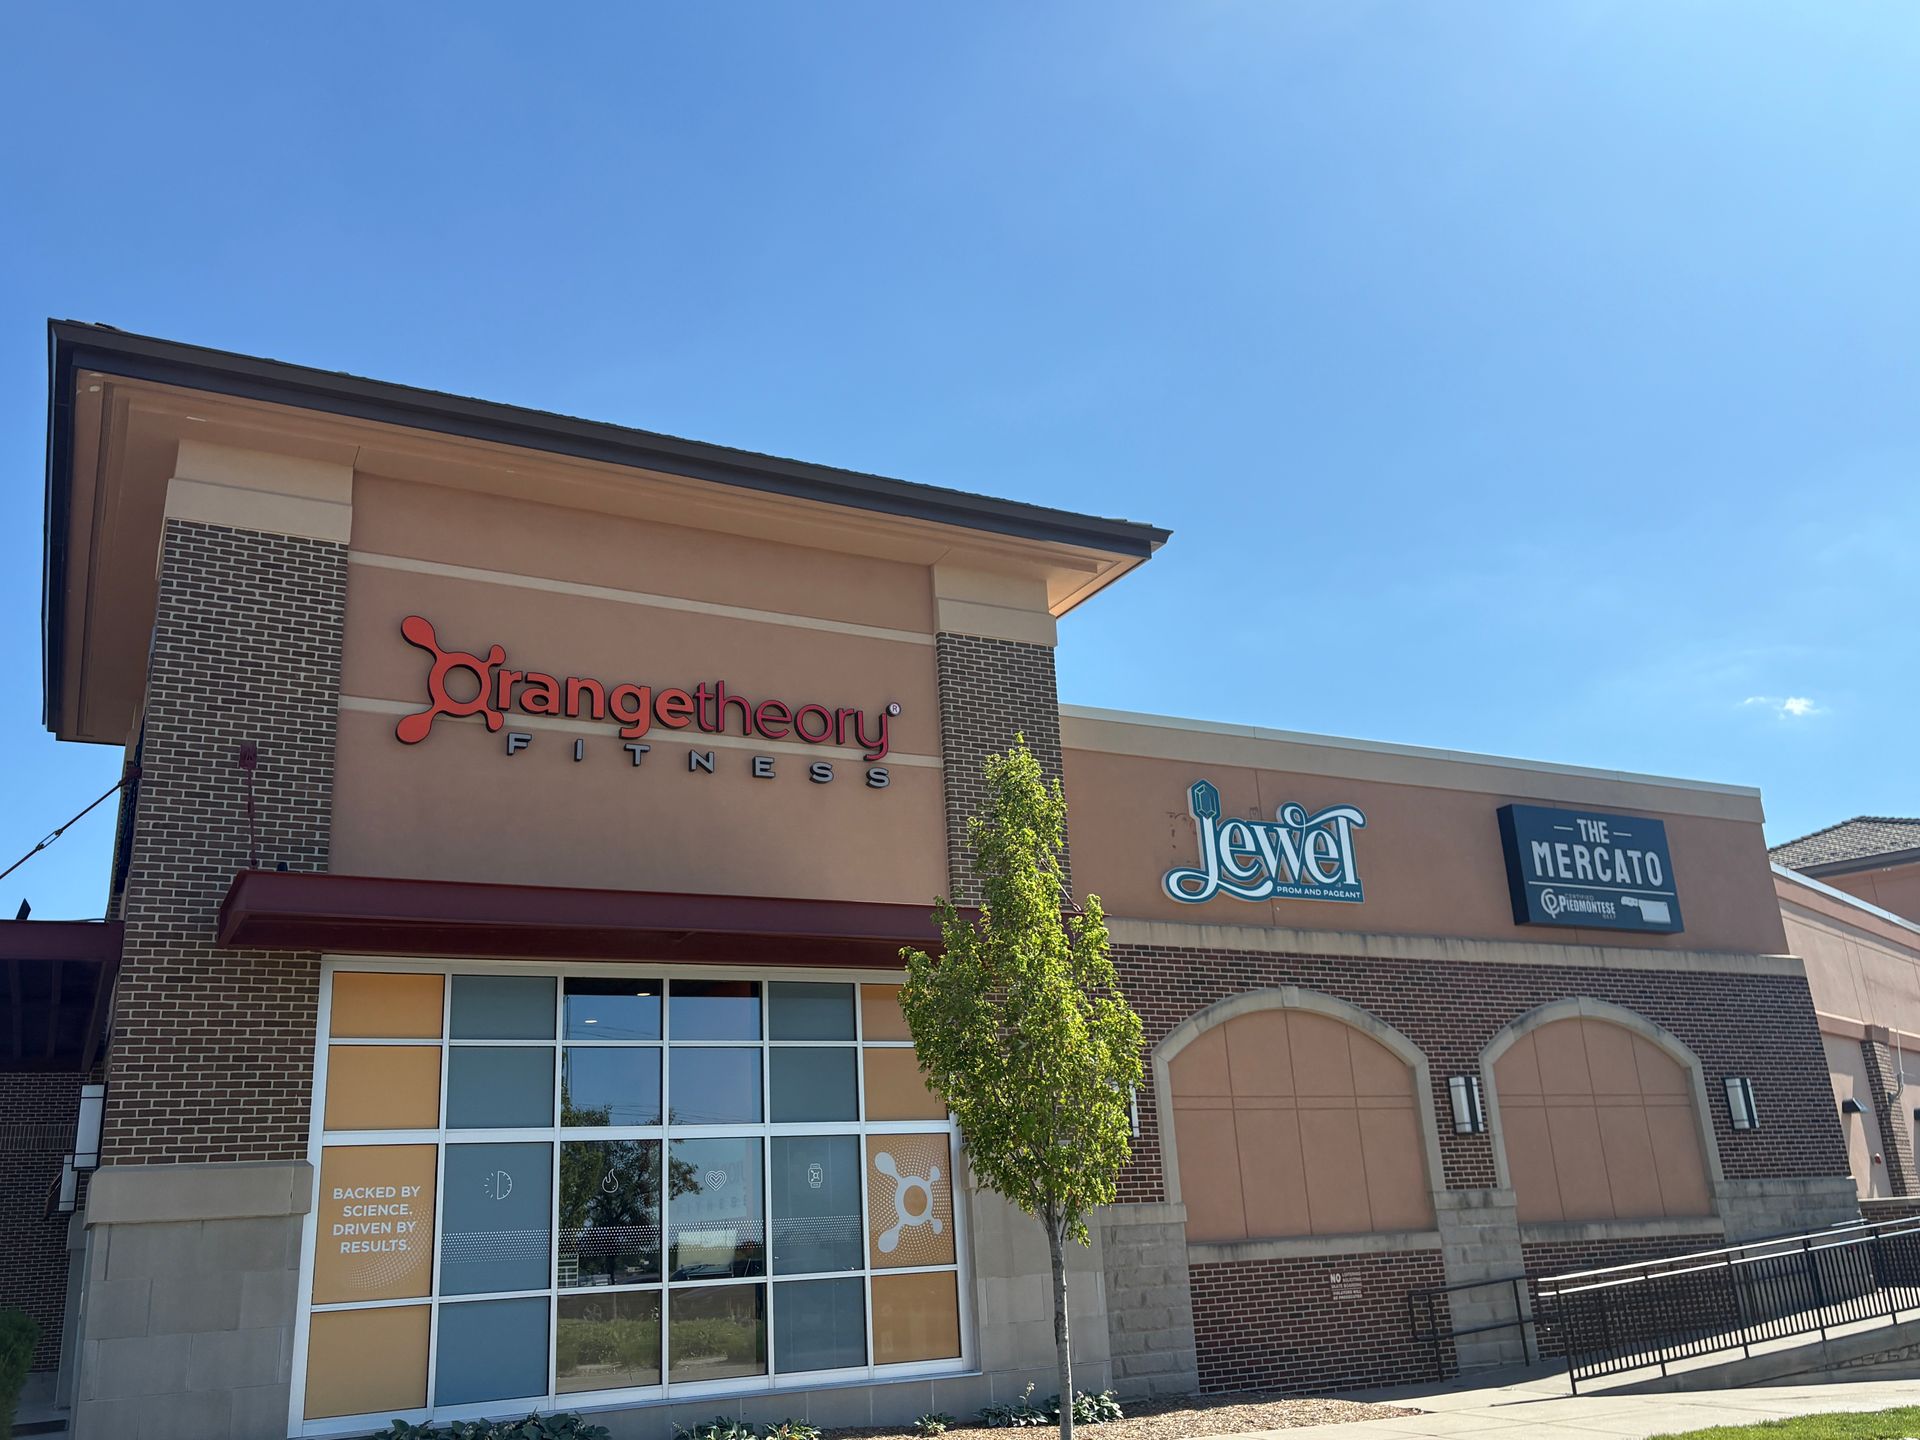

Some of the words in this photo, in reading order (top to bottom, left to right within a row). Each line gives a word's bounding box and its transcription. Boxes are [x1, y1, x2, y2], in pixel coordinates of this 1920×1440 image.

[507, 731, 891, 788] FITNESS
[1576, 818, 1610, 844] THE
[1531, 840, 1663, 887] MERCATO
[1276, 885, 1302, 895] PROM
[1304, 887, 1321, 896] AND
[1323, 889, 1361, 898] PAGEANT
[1558, 895, 1616, 914] PIEDMONTESE
[333, 1186, 397, 1200] BACKED
[401, 1185, 421, 1198] BY
[343, 1203, 413, 1217] SCIENCE.
[333, 1222, 391, 1236] DRIVEN
[396, 1221, 417, 1234] BY
[340, 1239, 411, 1254] RESULTS.
[1330, 1273, 1341, 1283] NO
